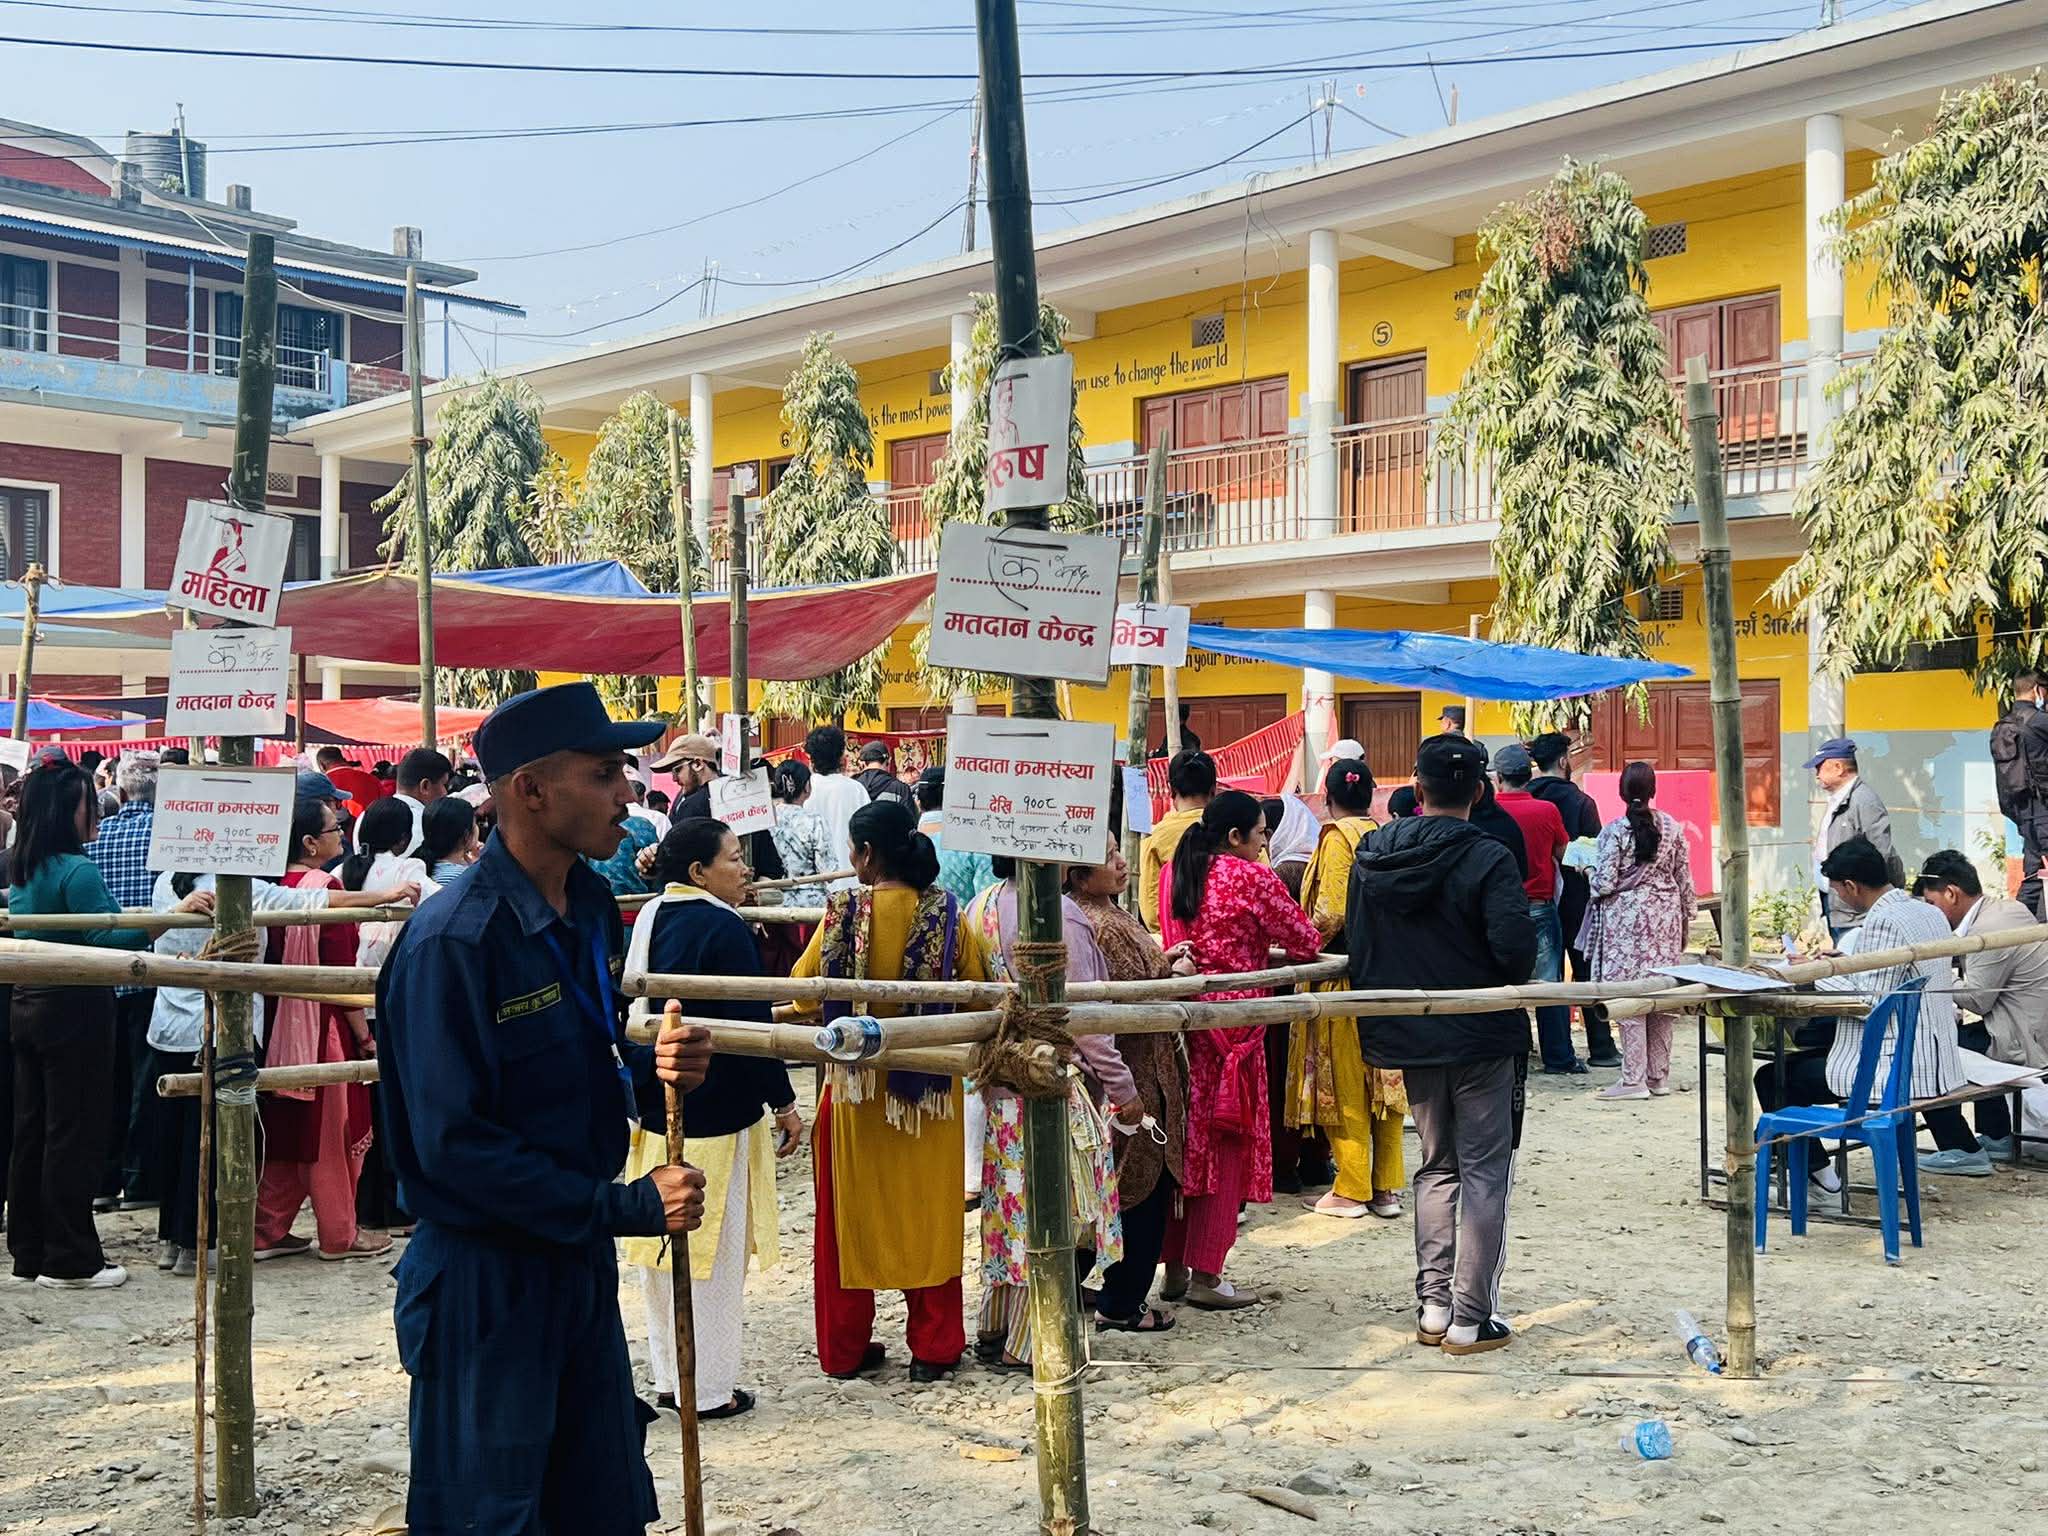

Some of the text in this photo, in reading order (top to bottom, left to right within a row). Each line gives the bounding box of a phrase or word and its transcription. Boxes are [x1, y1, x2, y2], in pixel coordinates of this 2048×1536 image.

[1091, 375, 1110, 389] use
[1114, 362, 1126, 385] to
[1129, 359, 1166, 385] change
[1170, 351, 1189, 376] the
[1192, 343, 1228, 371] world
[871, 407, 879, 427] is
[881, 402, 897, 426] the
[900, 397, 923, 423] most
[181, 567, 271, 613] महिला
[944, 612, 1098, 647] मतदान केन्द्र
[1194, 652, 1221, 673] your
[882, 668, 903, 684] Your
[176, 689, 277, 711] मतदान केन्द्र
[955, 756, 1095, 780] मतदाता क्रमसंख्या
[164, 800, 280, 815] मतदाता क्रमसंख्या
[989, 795, 1013, 815] देखि
[1065, 805, 1096, 821] सम्म
[193, 828, 215, 843] देखि
[256, 834, 280, 844] सम्म
